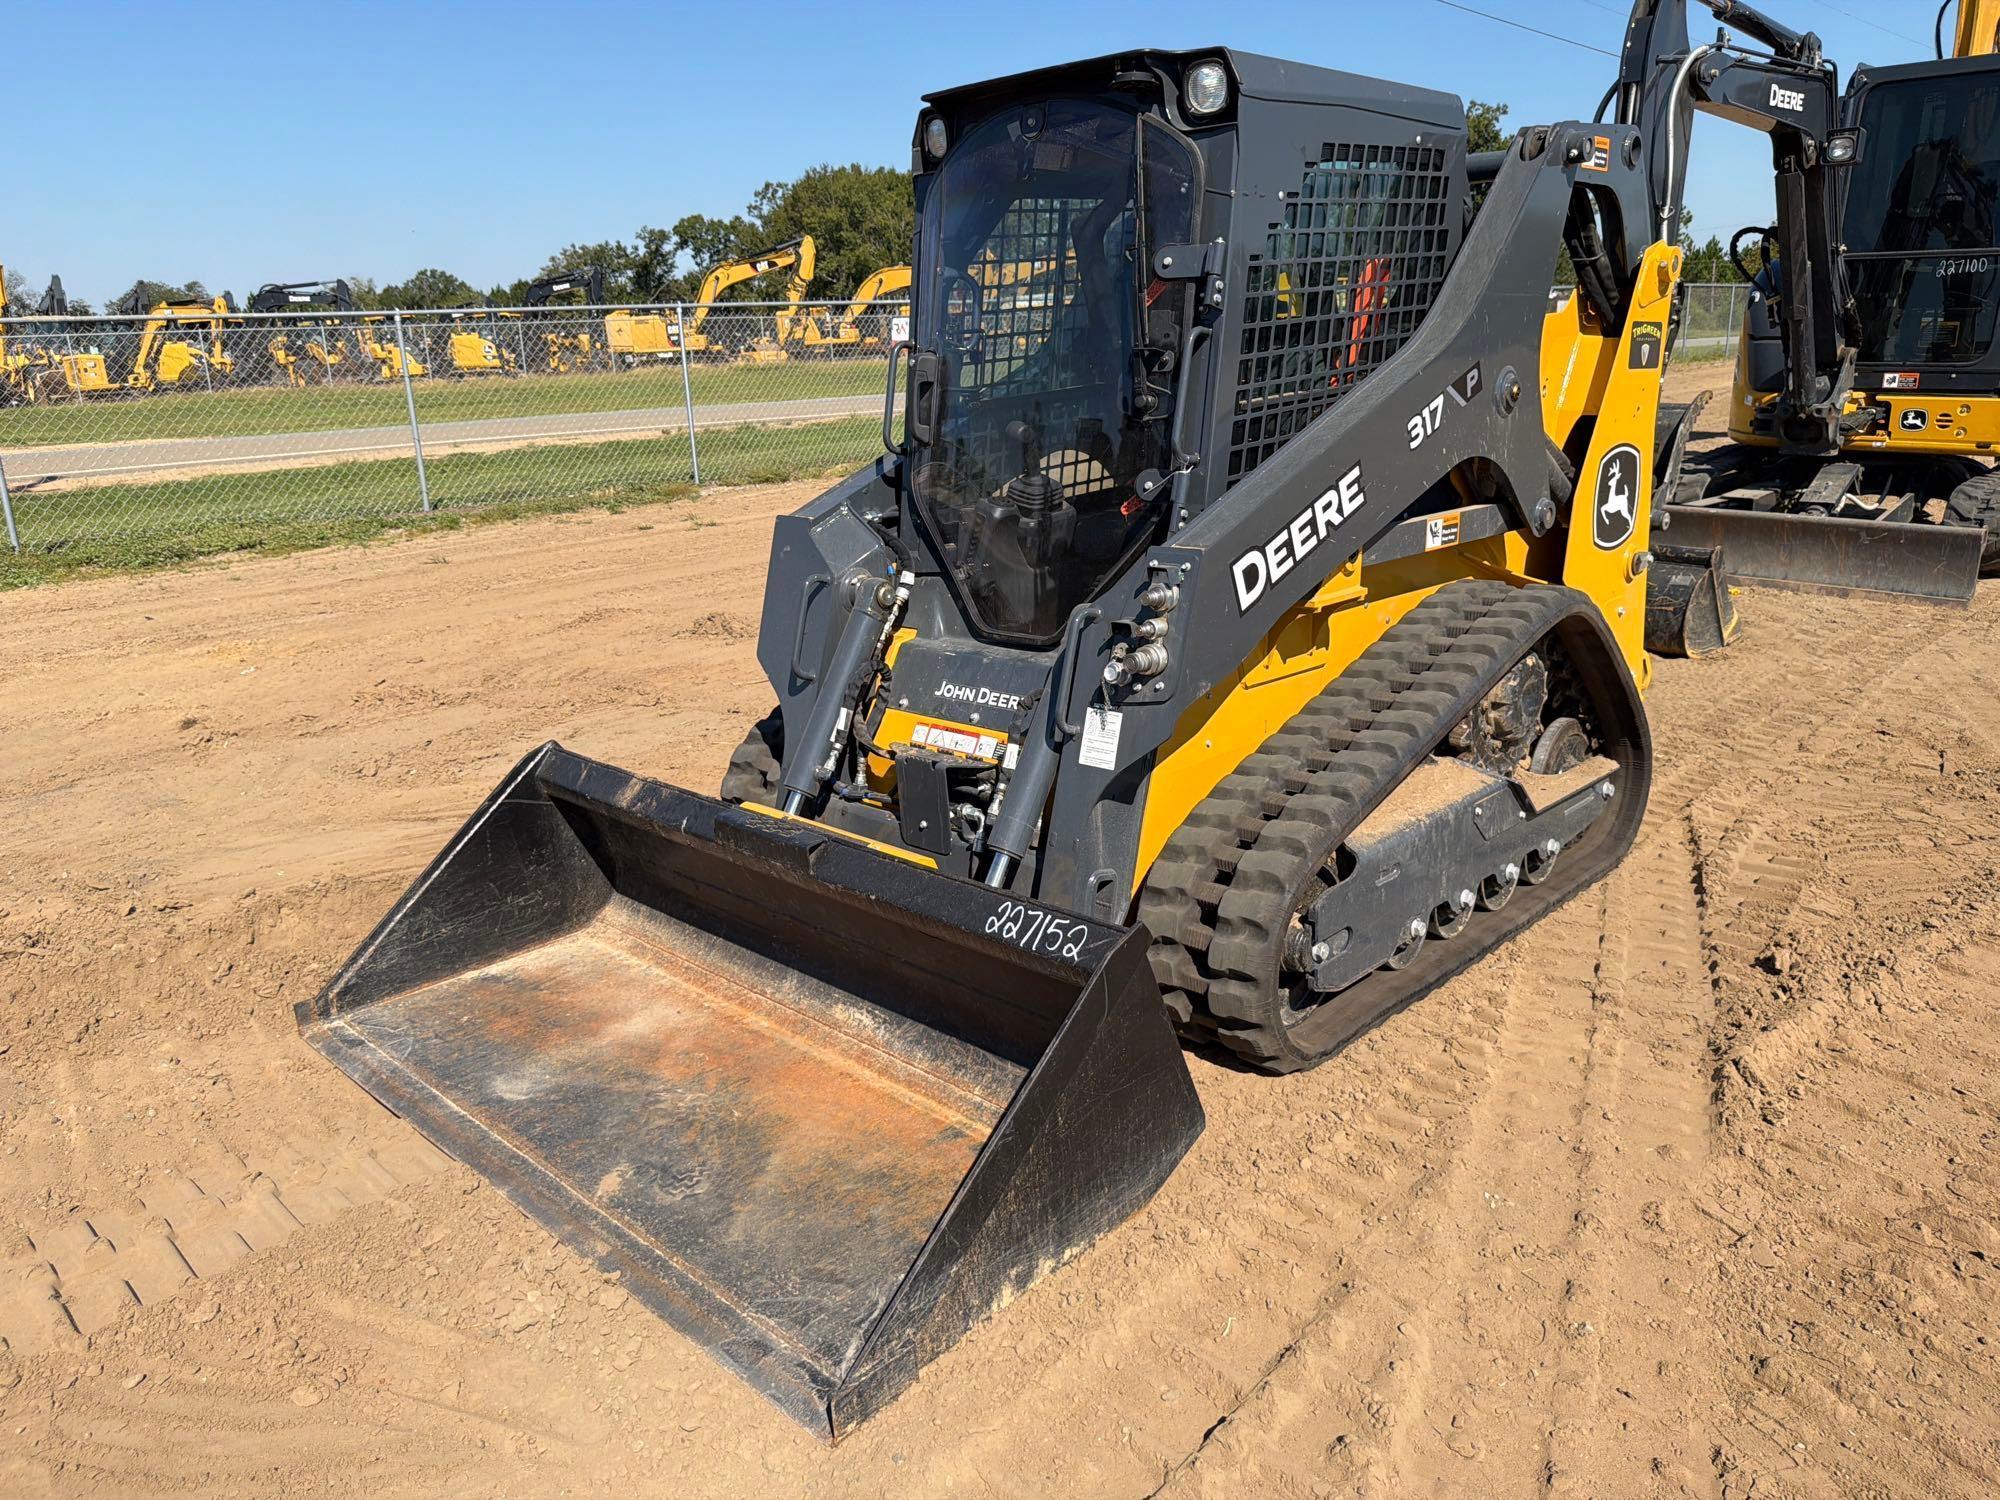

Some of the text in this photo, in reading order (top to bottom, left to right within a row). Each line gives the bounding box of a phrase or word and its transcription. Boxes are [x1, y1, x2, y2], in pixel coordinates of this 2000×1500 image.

[1769, 83, 1805, 112] DEERE
[1936, 257, 1988, 278] 227100
[1407, 368, 1479, 450] 317 P
[1232, 465, 1366, 613] DEERE
[934, 680, 1025, 710] JOHN DEER
[985, 901, 1088, 962] 227152
